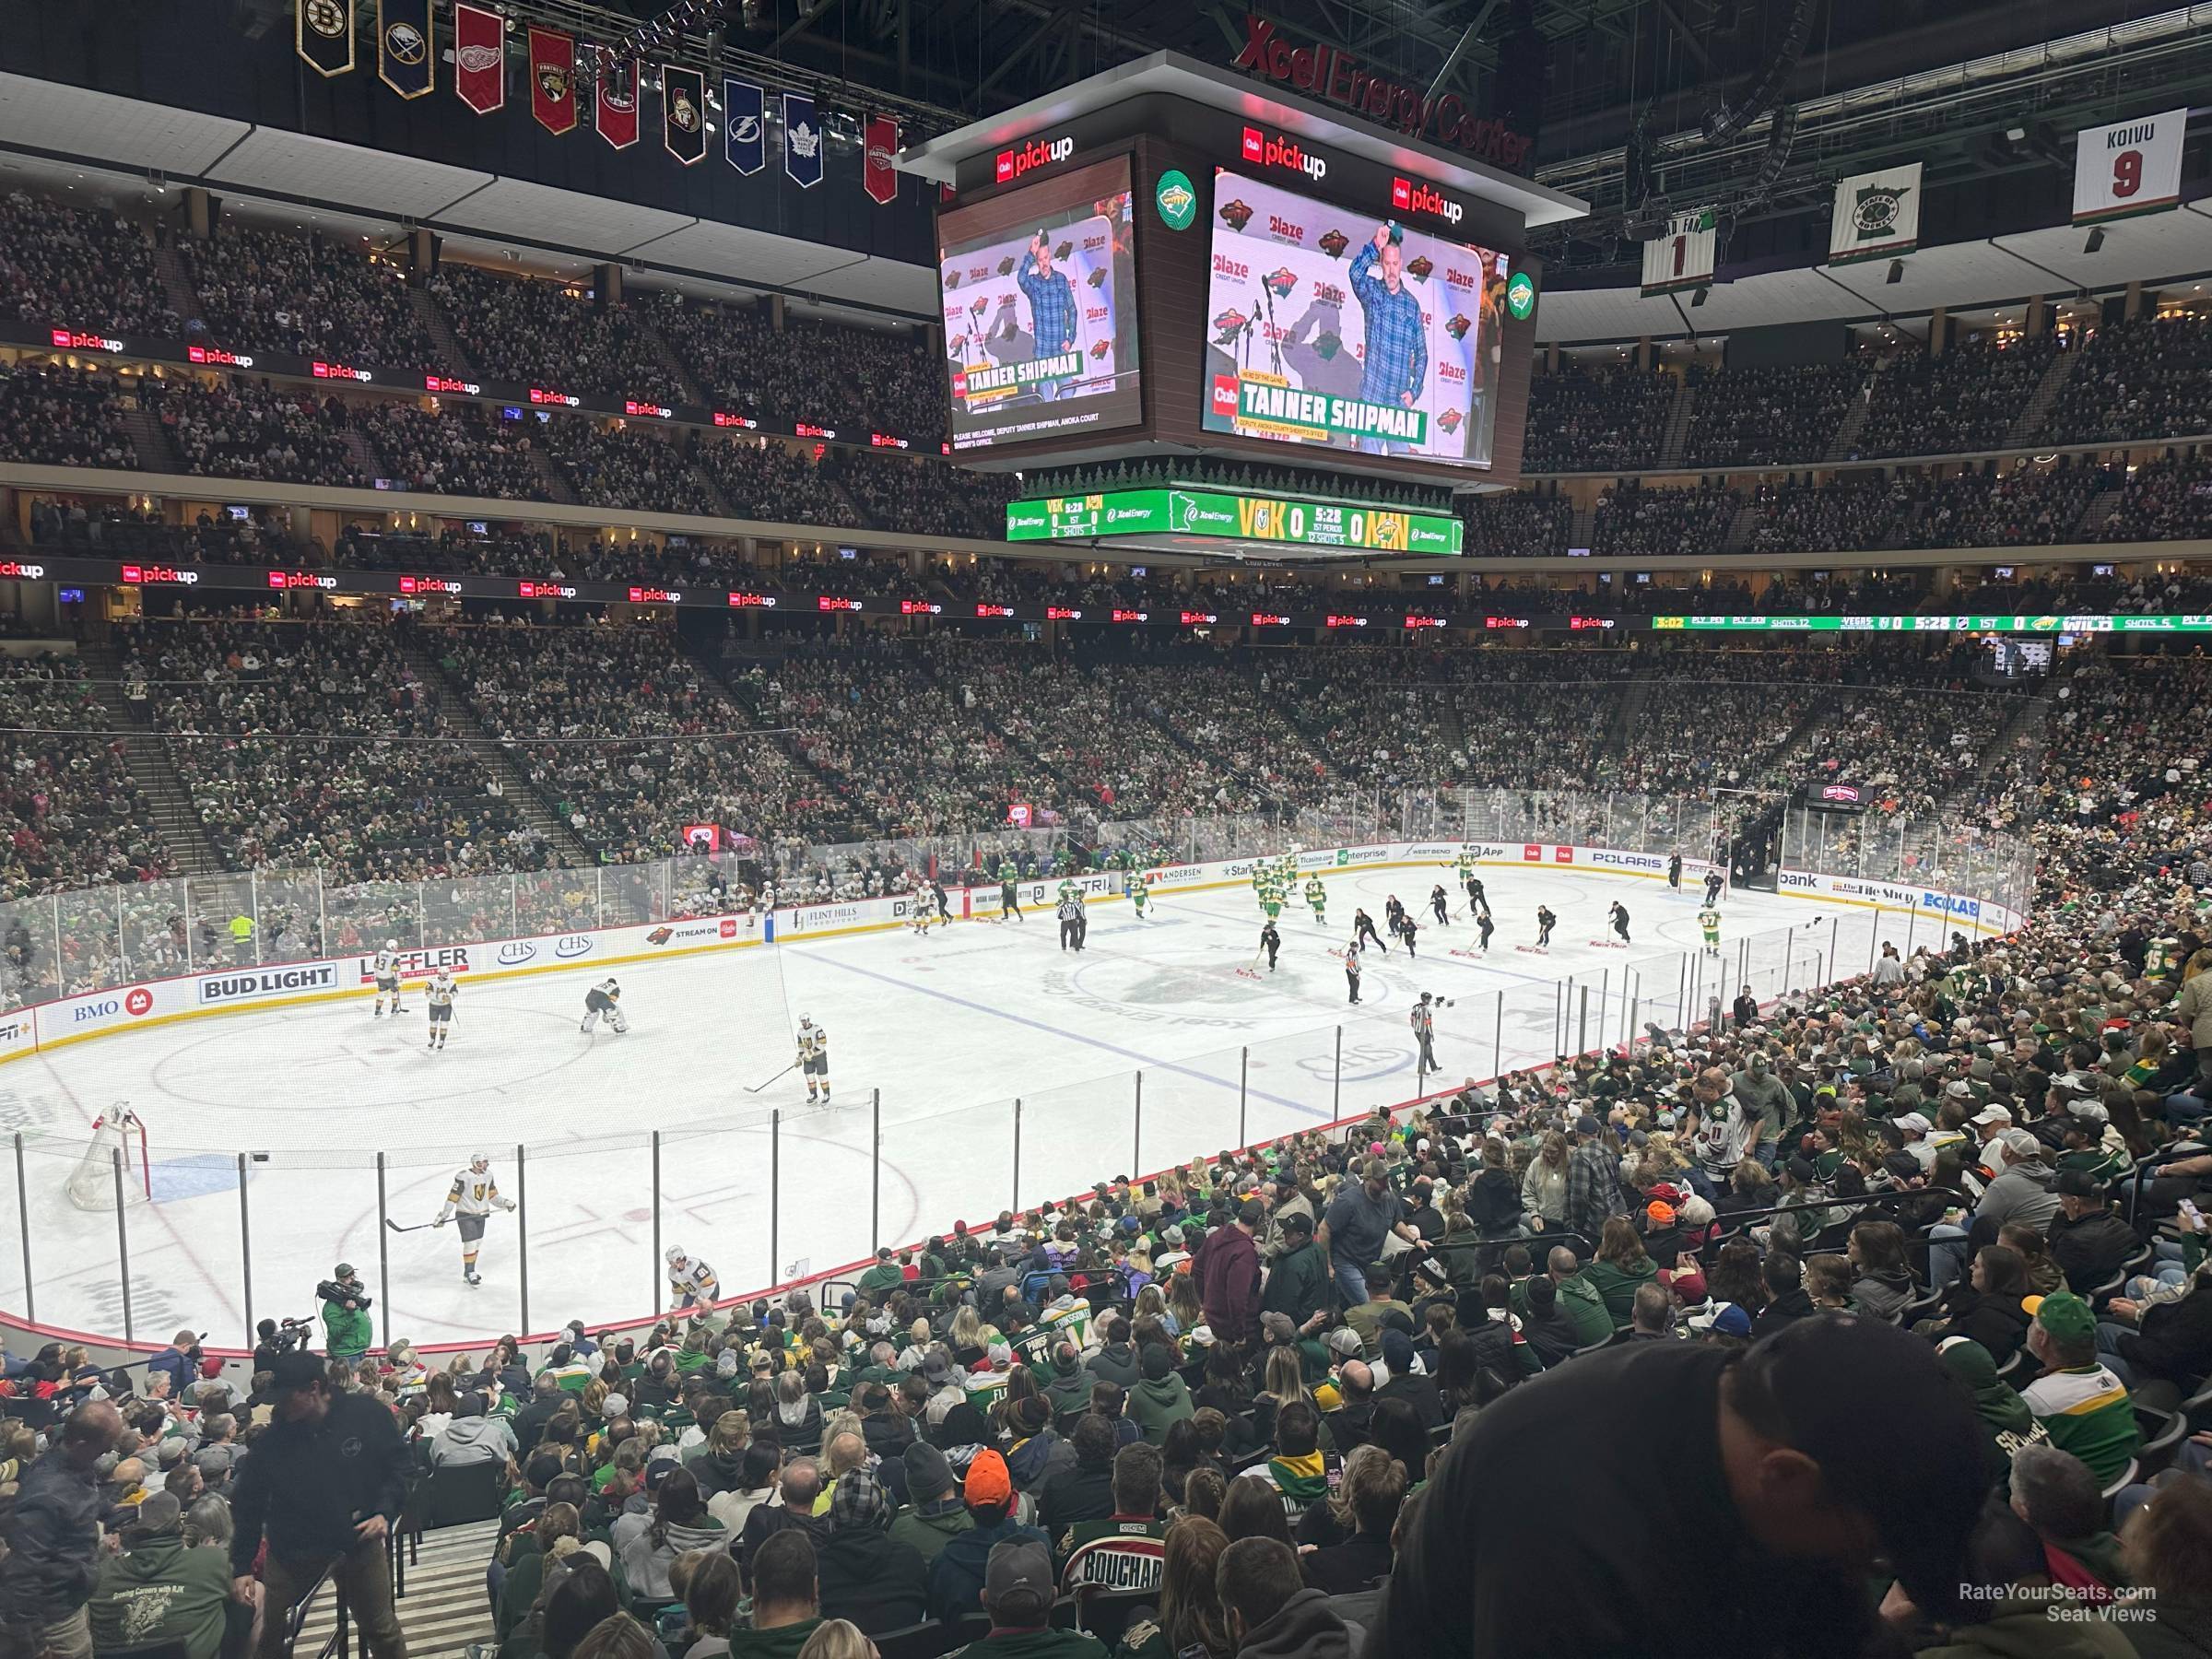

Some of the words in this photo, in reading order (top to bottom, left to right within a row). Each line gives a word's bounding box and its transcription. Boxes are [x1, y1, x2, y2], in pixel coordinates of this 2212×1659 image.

[2107, 123, 2155, 149] KOIVU
[1016, 136, 1073, 176] pickup
[1245, 137, 1260, 152] Cub
[1265, 135, 1326, 181] pickup
[2112, 149, 2144, 197] 9
[1394, 187, 1407, 200] Cub
[1411, 184, 1463, 224] pickup
[1859, 196, 1884, 211] STATE
[1269, 216, 1303, 240] Blaze
[1858, 216, 1891, 229] HOCKEY
[1672, 235, 1686, 276] 1
[1213, 254, 1249, 278] Blaze
[1446, 268, 1474, 288] Blaze
[1313, 281, 1346, 304] Blaze
[1087, 306, 1109, 323] Blaze
[72, 333, 124, 351] pickup
[206, 348, 253, 368] pickup
[329, 364, 372, 382] pickup
[968, 365, 1016, 391] TANNER
[1018, 353, 1077, 382] SHIPMAN
[1439, 361, 1466, 380] Blaze
[441, 378, 480, 394] pickup
[543, 391, 580, 407] pickup
[1214, 387, 1237, 404] Cub
[638, 403, 672, 418] pickup
[1243, 382, 1327, 424] TANNER
[1330, 400, 1420, 440] SHIPMAN
[725, 414, 757, 429] pickup
[953, 432, 971, 442] PLEASE
[996, 426, 1016, 436] DEPUTY
[1016, 423, 1036, 433] TANNER
[1061, 416, 1080, 426] ANOKA
[1080, 413, 1100, 422] COURT
[806, 424, 835, 439] pickup
[881, 434, 909, 449] pickup
[1065, 501, 1083, 513] 5:28
[1052, 513, 1058, 528] 0
[1091, 511, 1098, 524] 0
[1290, 508, 1304, 538] 0
[1314, 507, 1341, 523] 5:28
[1350, 513, 1363, 542] 0
[1064, 526, 1085, 536] SHOTS
[1313, 523, 1323, 533] 1ST
[1324, 524, 1342, 534] PERIOD
[1308, 533, 1315, 542] 12
[1315, 534, 1336, 544] SHOTS
[1338, 535, 1345, 545] 5
[144, 566, 198, 583] pickup
[288, 571, 337, 589] pickup
[418, 577, 462, 594] pickup
[535, 582, 576, 598] pickup
[643, 588, 680, 603] pickup
[741, 593, 776, 607] pickup
[831, 597, 862, 611] pickup
[912, 600, 941, 615] pickup
[987, 604, 1014, 618] pickup
[1057, 607, 1081, 620] pickup
[1122, 610, 1147, 622] pickup
[1190, 612, 1217, 624] pickup
[1262, 614, 1290, 626] pickup
[1336, 617, 1367, 627] pickup
[1416, 617, 1446, 628] pickup
[1498, 617, 1528, 629] pickup
[1656, 618, 1685, 629] 3:02
[1799, 618, 1810, 627] 12
[1842, 617, 1872, 626] VEGAS
[1892, 617, 1902, 630] 0
[1914, 617, 1950, 629] 5:28
[1980, 618, 1997, 629] 1ST
[2014, 617, 2024, 630] 0
[2062, 619, 2113, 631] WILD
[2161, 618, 2171, 627] 5
[1341, 848, 1386, 863] enterprise
[1593, 853, 1663, 869] POLARIS
[1164, 868, 1202, 878] ANDERSEN
[1130, 880, 1142, 889] 27
[1923, 892, 1980, 917] ECOLAB
[810, 911, 832, 921] FLINT
[834, 907, 857, 918] HILLS
[676, 928, 700, 938] STREAM
[703, 927, 717, 935] ON
[500, 941, 533, 958] CHS
[559, 935, 590, 951] CHS
[205, 977, 257, 998] BUD
[262, 969, 333, 990] LIGHT
[74, 1000, 120, 1022] BMO
[1121, 1524, 1146, 1533] CCM
[1083, 1551, 1163, 1587] BOUCHAR
[159, 1584, 171, 1594] with
